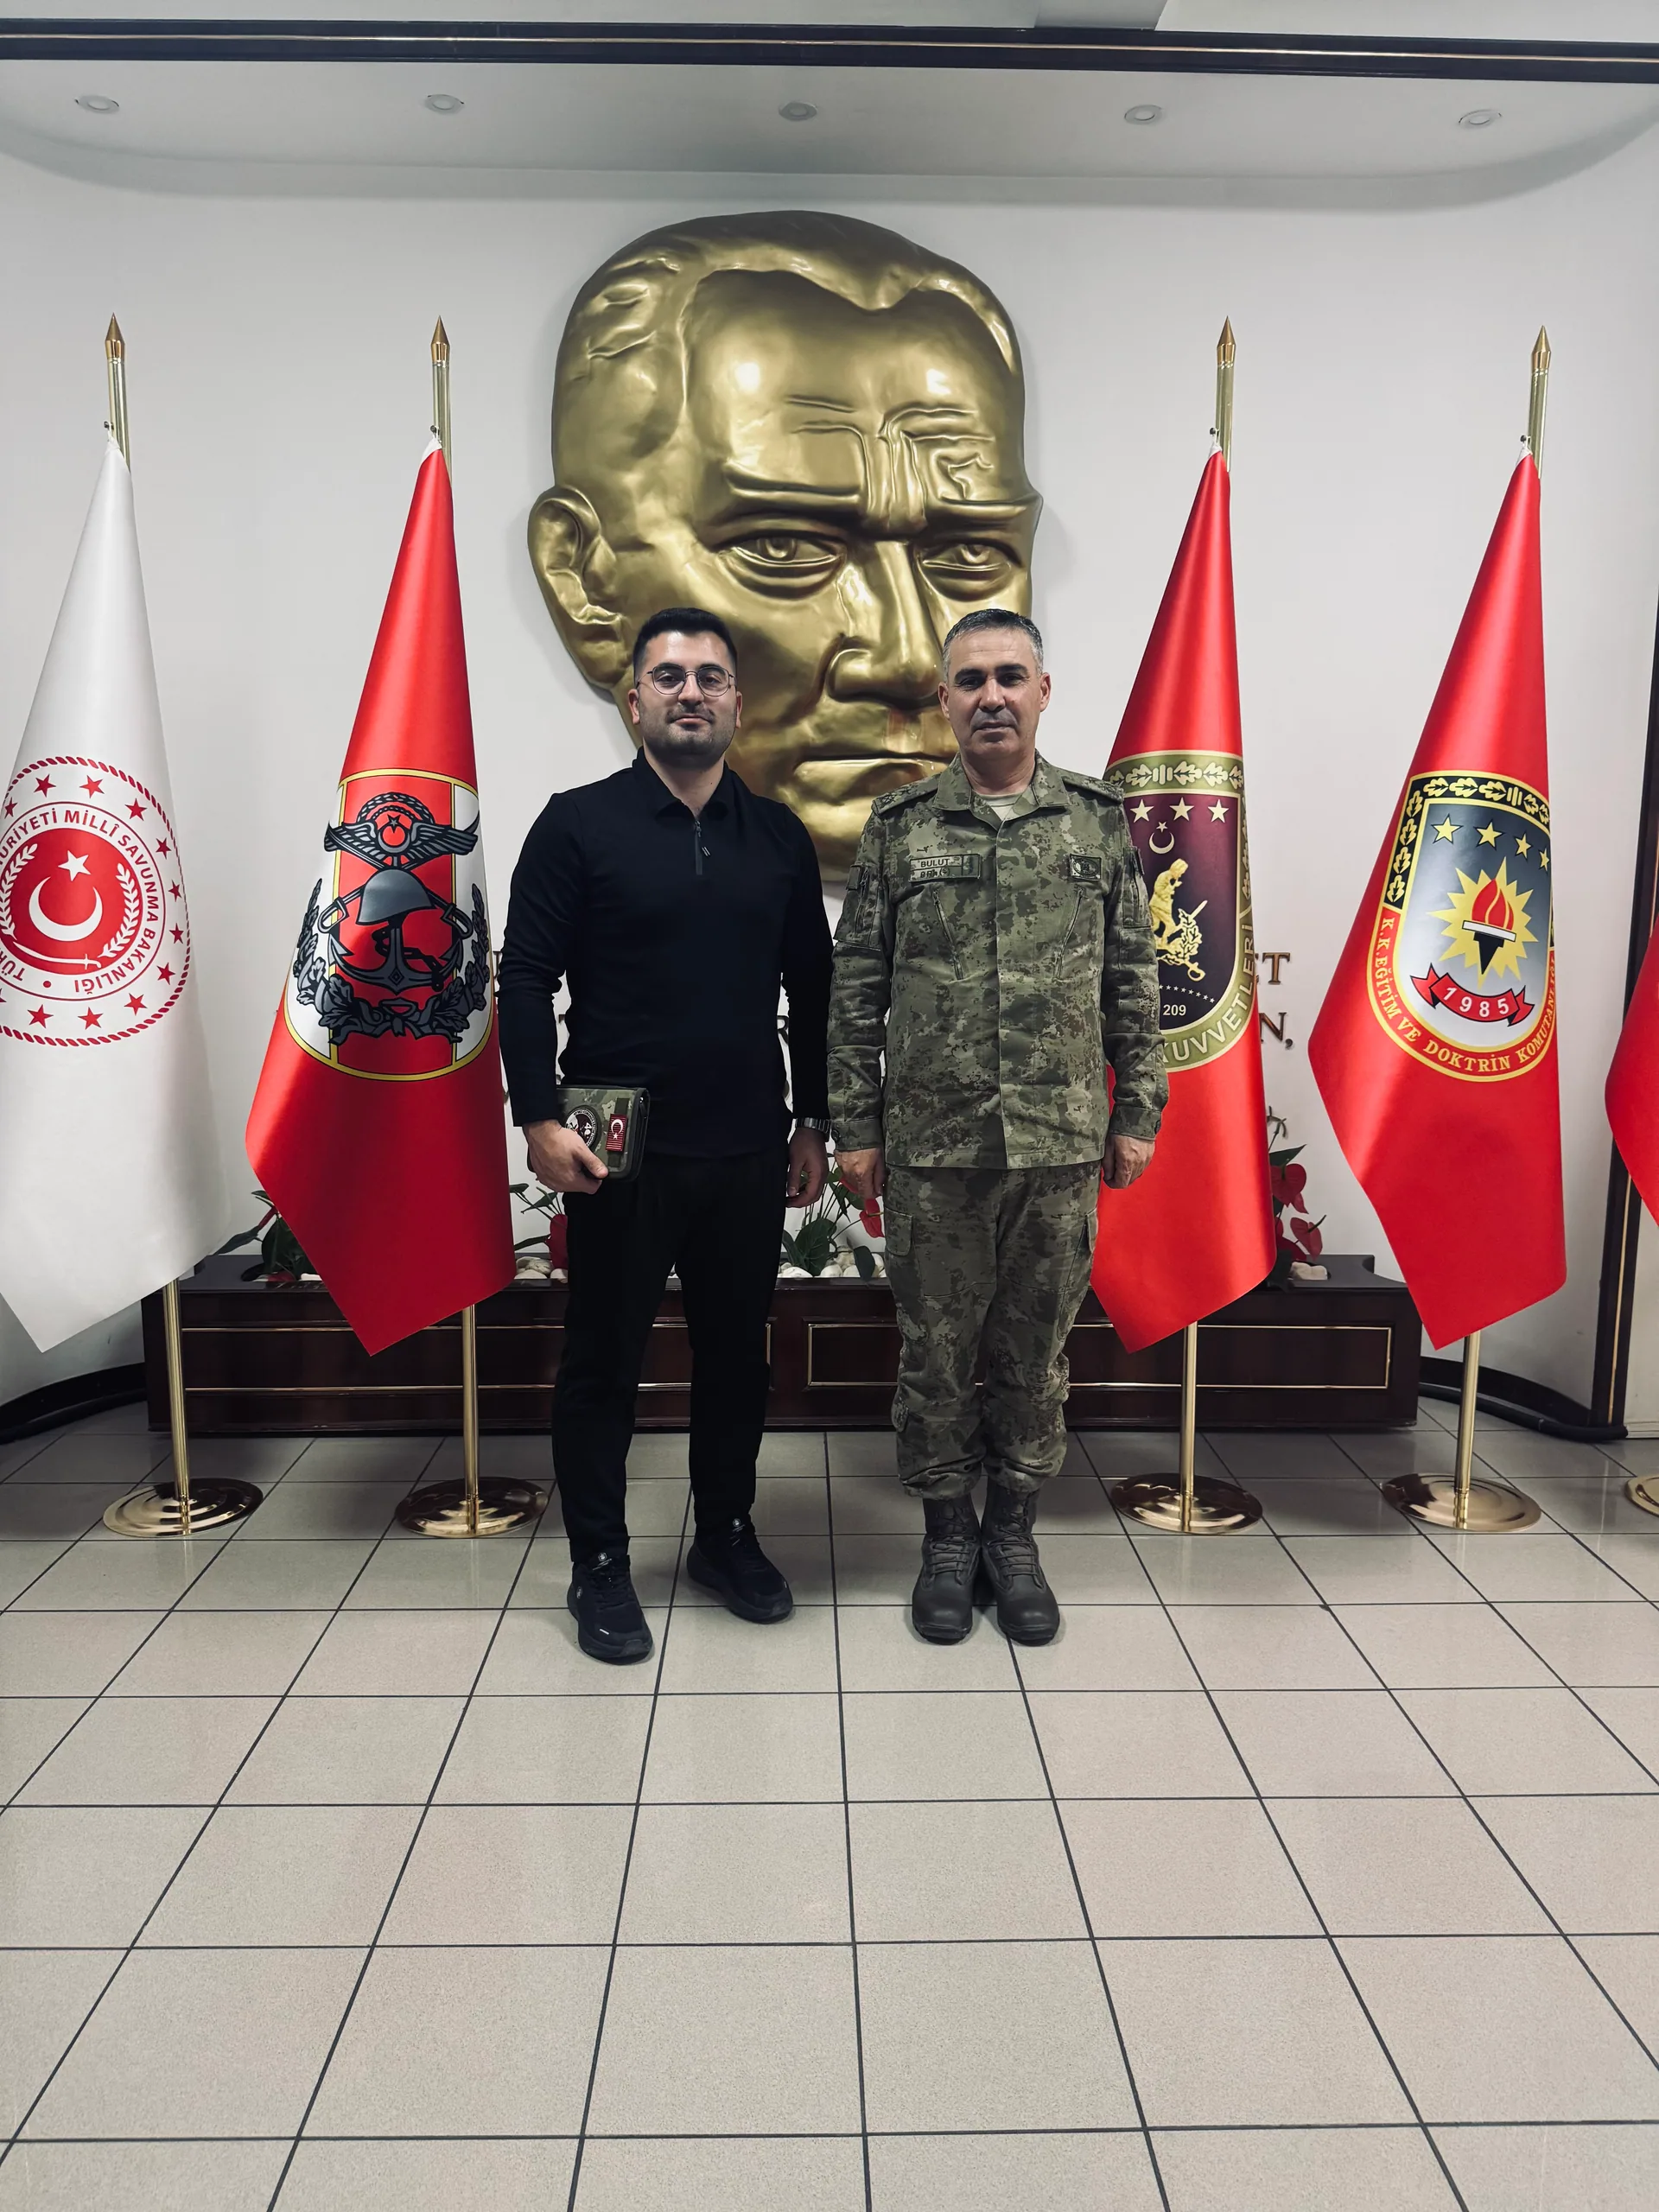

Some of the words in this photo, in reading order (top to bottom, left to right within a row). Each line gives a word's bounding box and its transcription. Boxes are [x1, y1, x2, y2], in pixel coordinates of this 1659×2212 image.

[0, 808, 57, 863] URİYETİ
[64, 810, 119, 838] MİLLÎ
[118, 835, 159, 922] SAVUNMA
[920, 858, 950, 868] BULUT
[74, 927, 156, 995] BAKANLIĞI
[1254, 952, 1291, 985] T
[1162, 1004, 1187, 1016] 209
[1443, 987, 1510, 1018] 1985
[1397, 1016, 1421, 1042] VE
[1422, 1039, 1510, 1073] DOKTRİN
